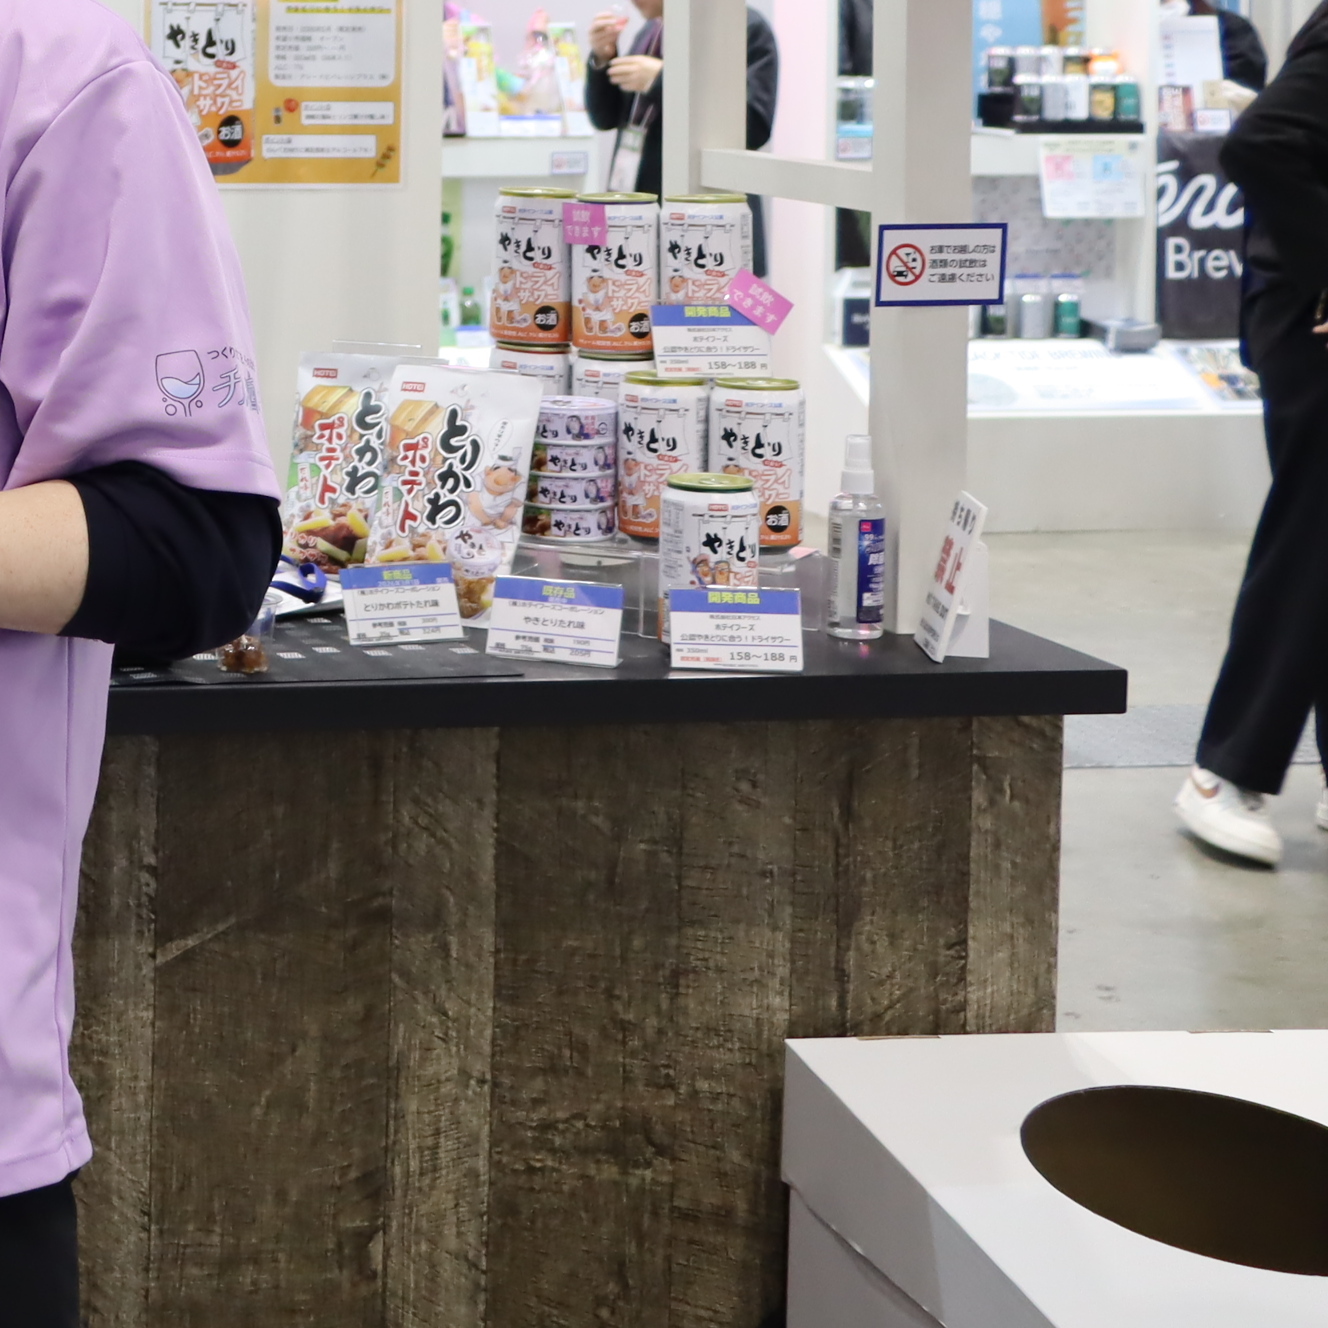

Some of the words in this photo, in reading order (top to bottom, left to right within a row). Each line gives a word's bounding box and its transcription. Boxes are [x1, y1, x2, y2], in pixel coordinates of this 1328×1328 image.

[166, 23, 236, 60] やきとり
[193, 71, 245, 95] ドライ
[196, 96, 244, 115] サワー
[218, 125, 244, 141] お酒
[565, 225, 602, 238] できます
[499, 232, 552, 262] やきとり
[667, 239, 724, 269] やきとり
[929, 244, 996, 254] お車でお越しの方は
[585, 244, 643, 269] やきとり
[928, 258, 988, 269] 酒類の試飲は
[515, 272, 561, 288] ドライ
[927, 273, 995, 283] ご遠慮ください
[608, 278, 652, 295] ドライ
[517, 289, 559, 304] サワー
[610, 296, 650, 313] サワー
[684, 306, 732, 318] 開発商品
[733, 288, 778, 324] できます
[534, 313, 558, 326] お酒
[629, 320, 651, 334] お酒
[622, 422, 678, 454] やきとり
[720, 426, 782, 459] やきとり
[312, 415, 346, 508] ポテト
[425, 405, 482, 529] とりかわ
[396, 436, 431, 536] ポテト
[765, 513, 790, 526] お酒
[702, 532, 756, 563] やきとり
[708, 591, 761, 604] 開発商品
[523, 616, 586, 630] やきとりたれ味
[714, 623, 755, 632] ホテイフーズ
[789, 655, 798, 663] 円
